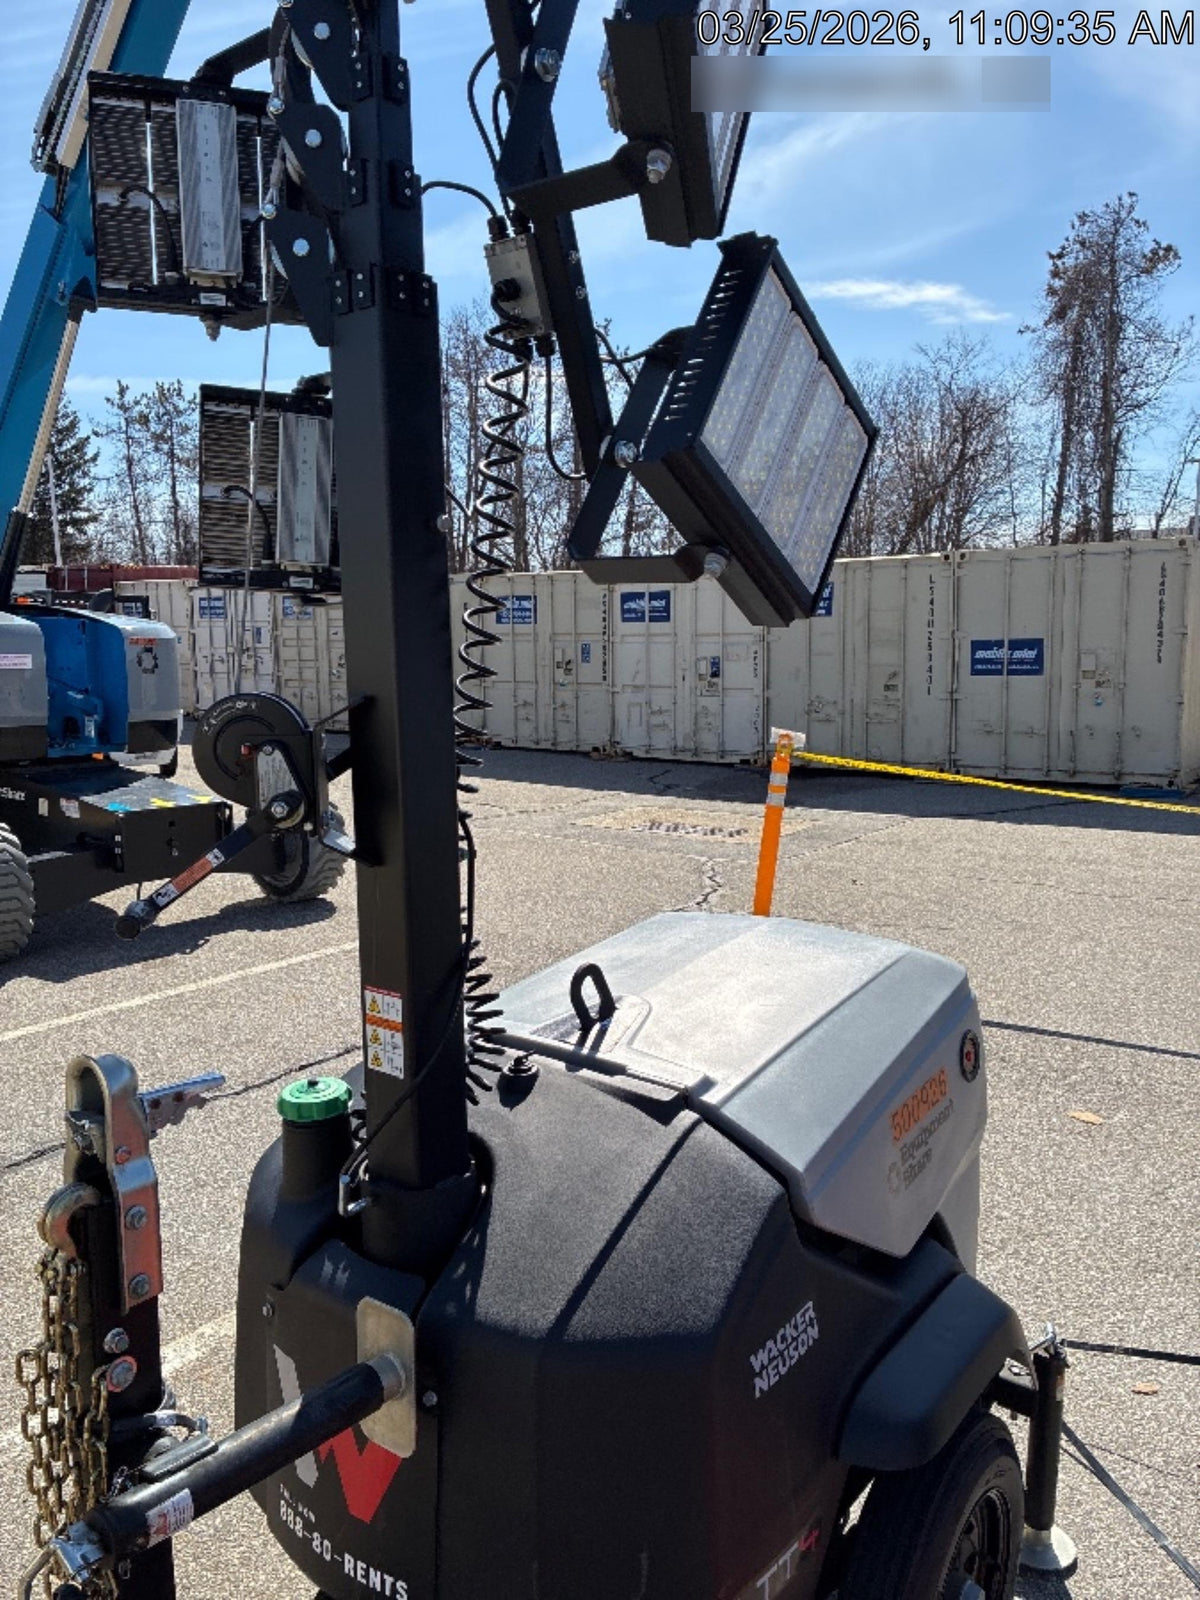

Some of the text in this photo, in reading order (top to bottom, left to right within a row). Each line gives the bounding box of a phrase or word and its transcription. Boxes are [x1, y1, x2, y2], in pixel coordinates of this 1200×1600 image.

[750, 1300, 817, 1374] WACKER
[753, 1318, 820, 1399] NEUSON
[279, 1499, 409, 1600] 888-80-RENTS
